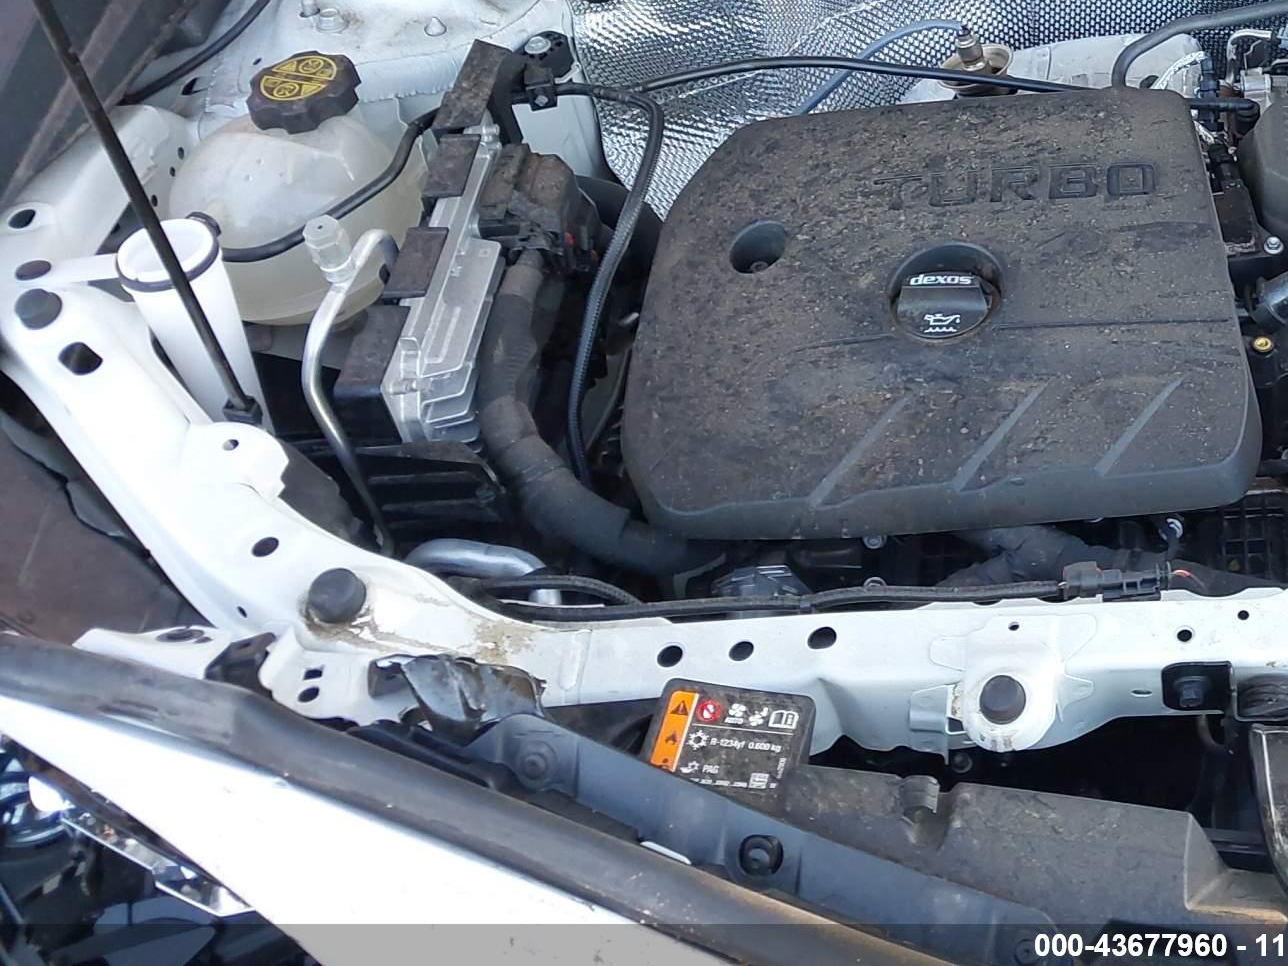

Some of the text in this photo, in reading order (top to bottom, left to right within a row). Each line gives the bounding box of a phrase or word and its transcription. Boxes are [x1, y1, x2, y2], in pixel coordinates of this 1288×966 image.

[873, 161, 1155, 210] TURBO
[910, 273, 974, 285] dexos
[702, 764, 719, 774] PAG
